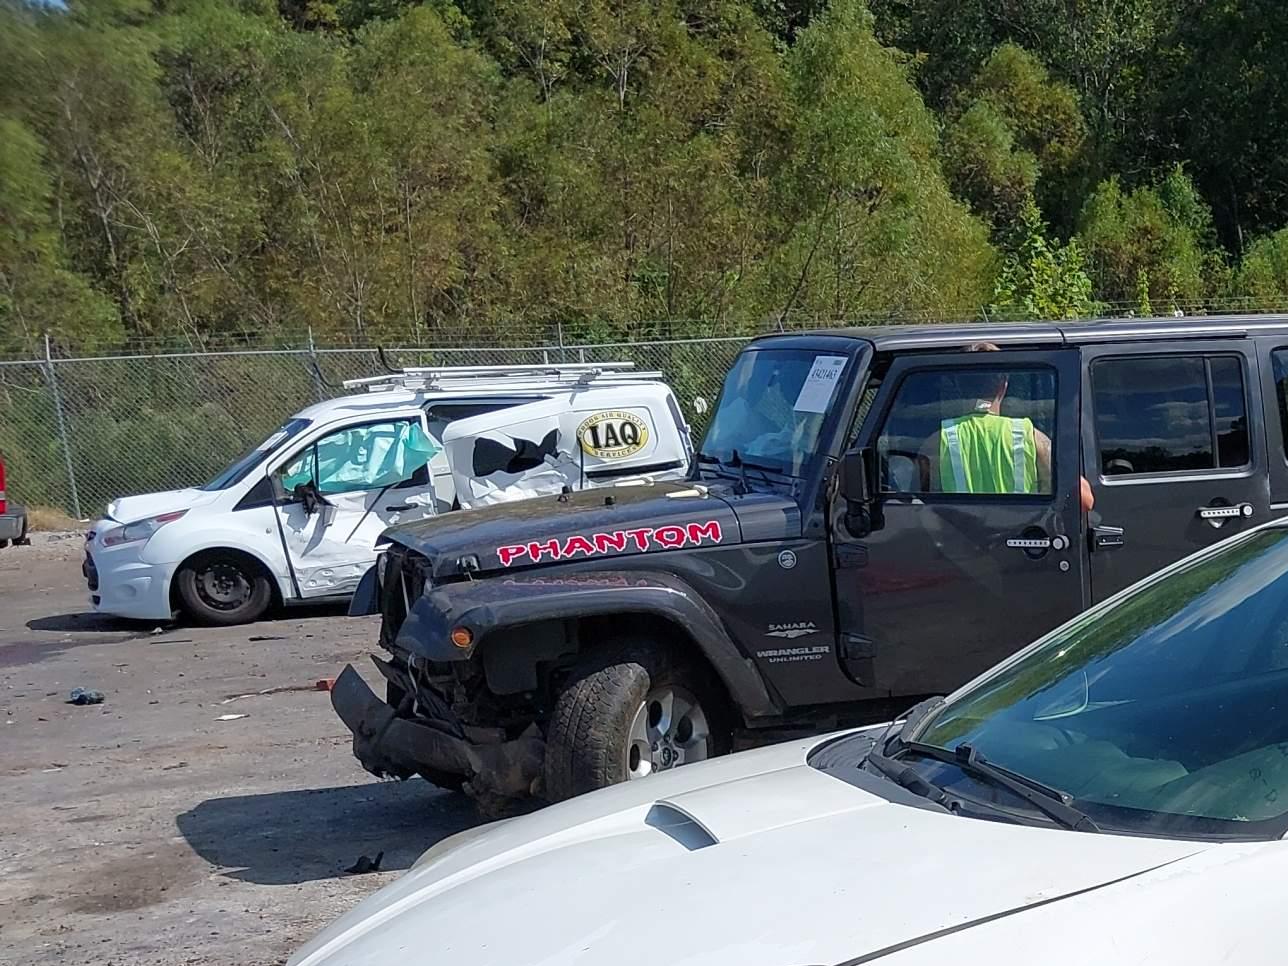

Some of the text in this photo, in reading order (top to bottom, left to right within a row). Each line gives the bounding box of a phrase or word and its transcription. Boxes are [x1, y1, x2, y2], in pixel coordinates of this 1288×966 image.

[589, 421, 641, 449] IAQ
[497, 520, 723, 566] PHANTOM
[768, 621, 816, 631] SAHARA
[756, 646, 830, 658] WRANGLER
[769, 654, 822, 663] UNLIMITED
